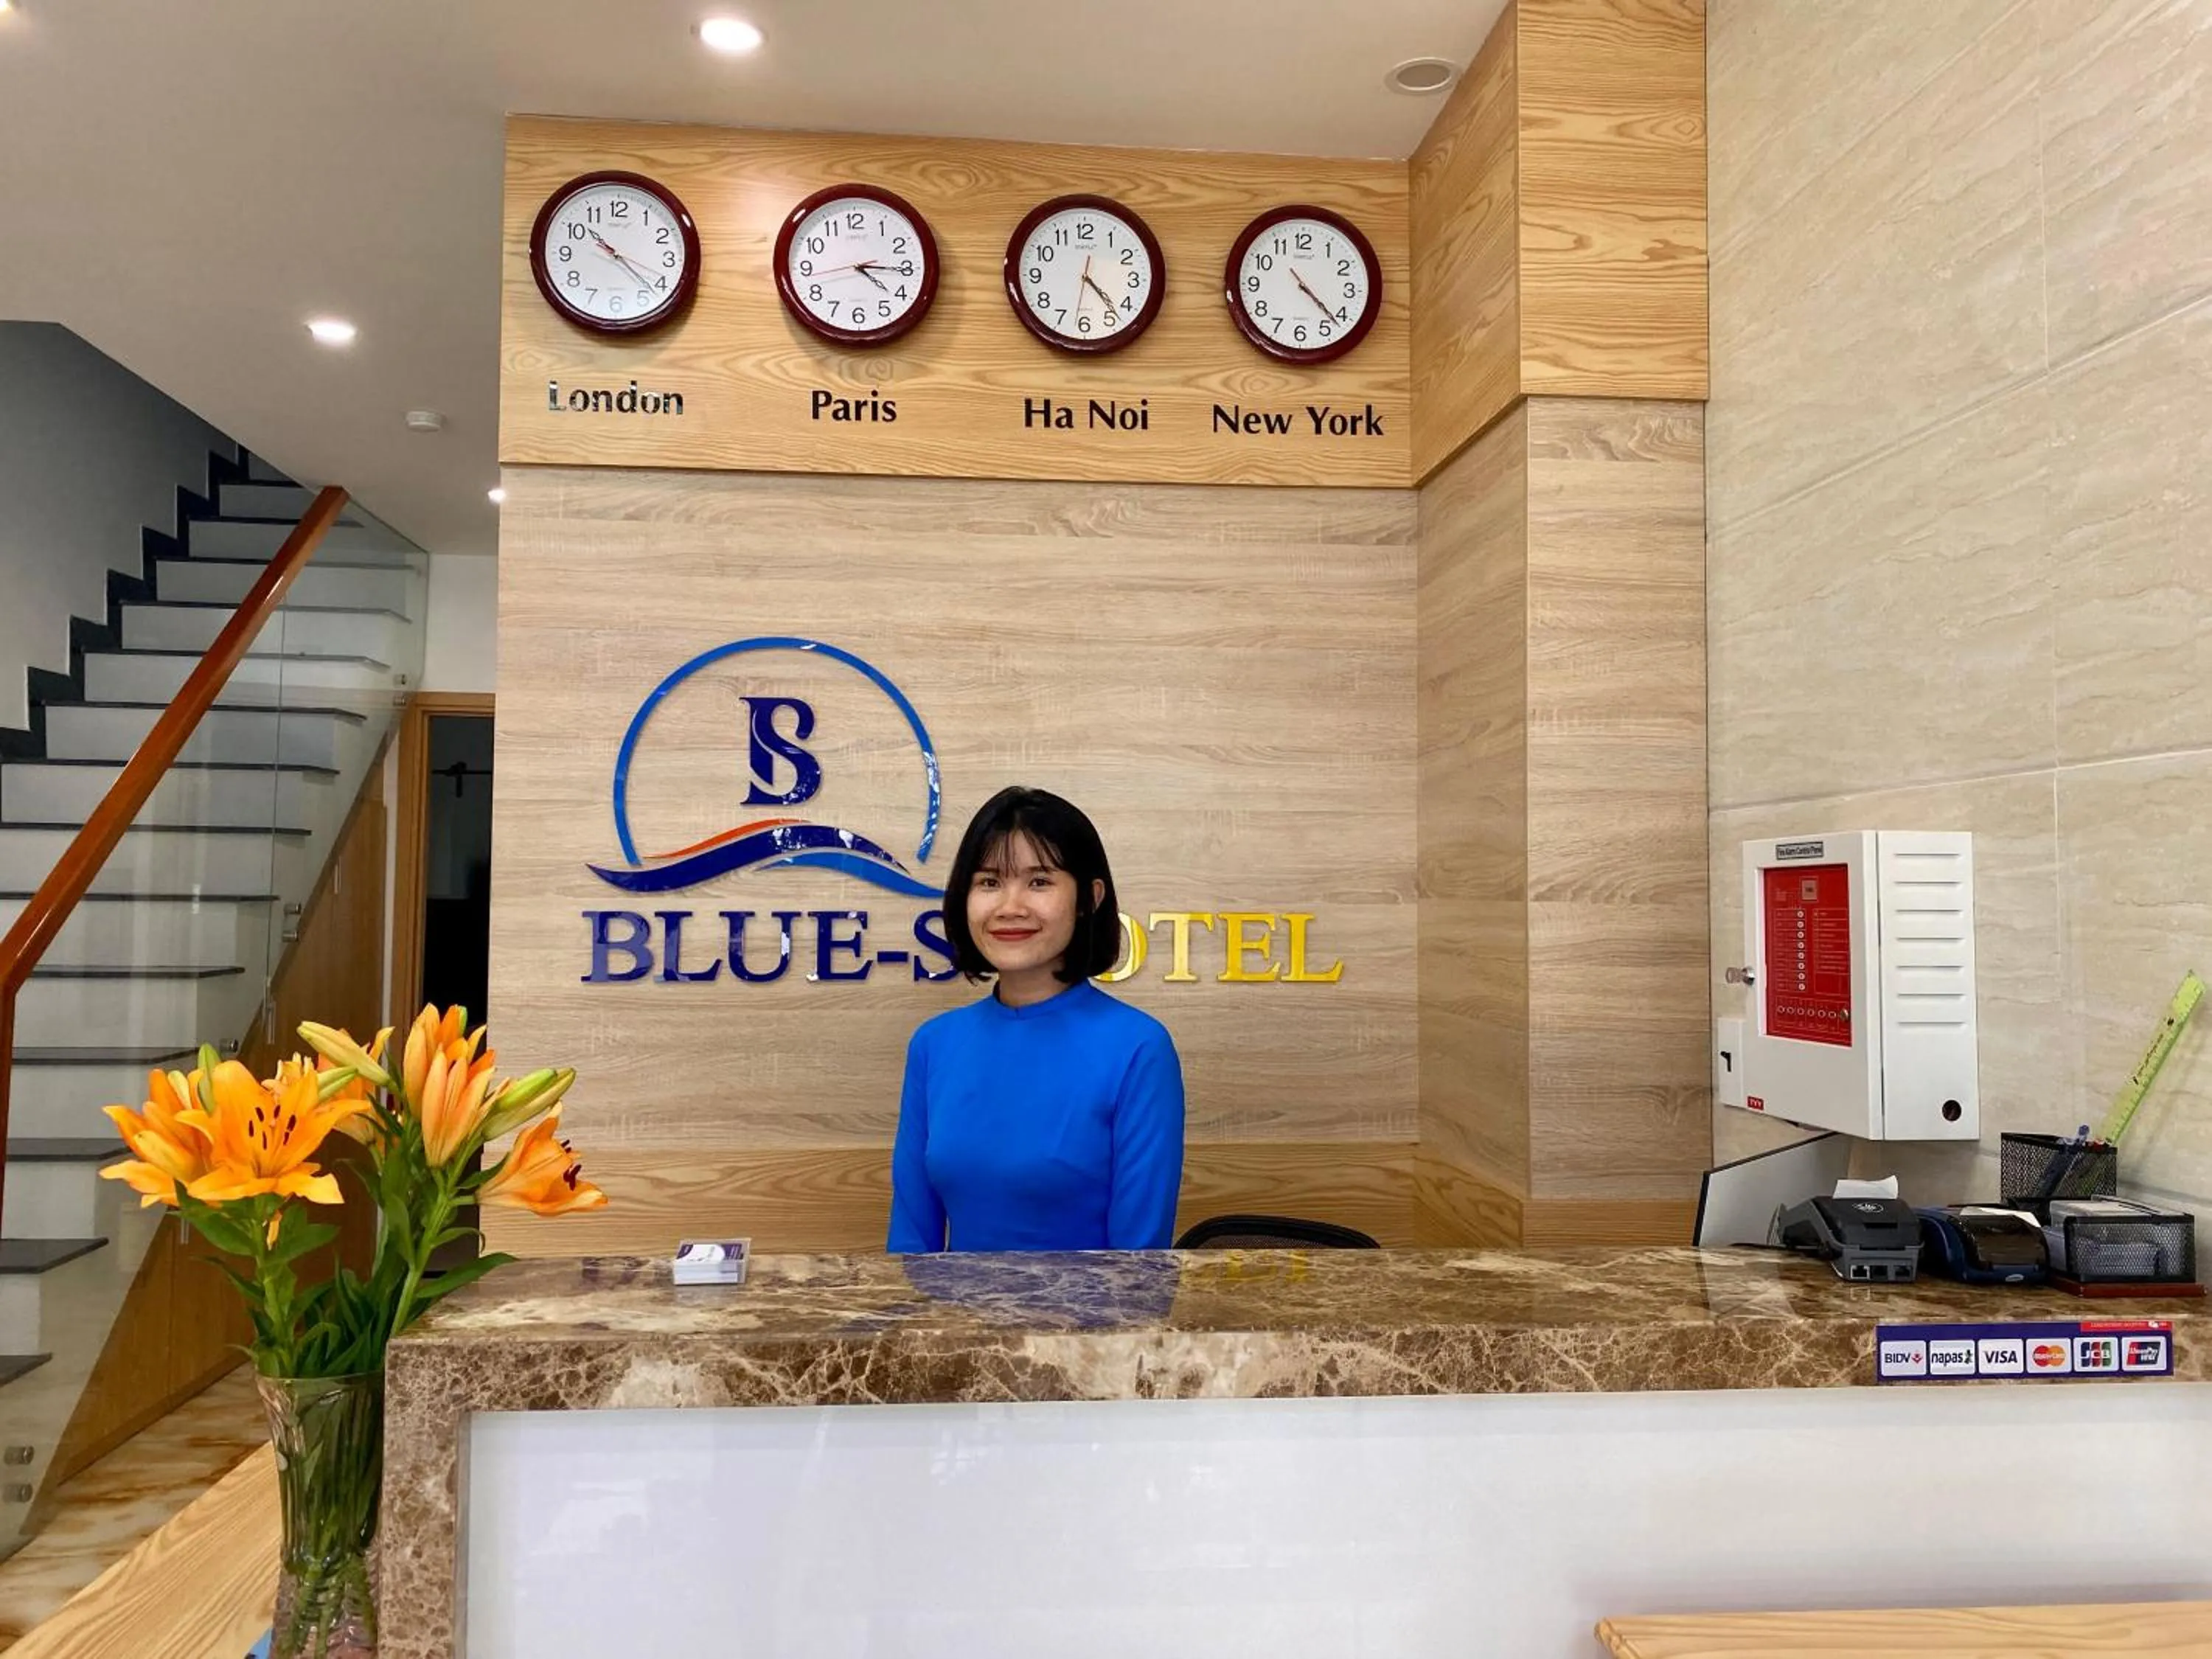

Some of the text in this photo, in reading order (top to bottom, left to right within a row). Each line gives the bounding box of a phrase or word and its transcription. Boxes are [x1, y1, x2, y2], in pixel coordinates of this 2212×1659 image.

[587, 207, 601, 223] 11
[611, 201, 628, 218] 12
[643, 209, 648, 226] 1
[825, 220, 838, 236] 11
[846, 214, 864, 229] 12
[879, 221, 884, 236] 1
[568, 223, 585, 240] 10
[655, 229, 669, 244] 2
[1055, 229, 1068, 246] 11
[1077, 223, 1093, 240] 12
[807, 237, 824, 254] 10
[893, 237, 905, 254] 2
[1108, 232, 1113, 248] 1
[1274, 238, 1287, 255] 11
[1295, 233, 1312, 250] 12
[559, 246, 571, 262] 9
[1037, 246, 1054, 262] 10
[1121, 249, 1133, 265] 2
[1326, 242, 1331, 258] 1
[663, 251, 675, 268] 3
[1256, 254, 1273, 271] 10
[800, 260, 813, 276] 9
[900, 260, 914, 276] 3
[1029, 268, 1042, 284] 9
[1338, 260, 1350, 276] 2
[567, 271, 580, 288] 8
[654, 276, 667, 292] 4
[1127, 271, 1139, 288] 3
[1248, 276, 1259, 292] 9
[585, 288, 598, 305] 7
[637, 290, 650, 307] 5
[810, 284, 822, 301] 8
[894, 285, 907, 301] 4
[1343, 283, 1355, 299] 3
[609, 296, 622, 312] 6
[1037, 292, 1050, 308] 8
[1121, 296, 1133, 311] 4
[828, 301, 840, 317] 7
[852, 307, 865, 324] 6
[878, 301, 891, 316] 5
[1255, 301, 1267, 316] 8
[1336, 307, 1347, 321] 4
[1054, 310, 1066, 324] 7
[1078, 317, 1091, 333] 6
[1104, 310, 1116, 327] 5
[1272, 318, 1284, 333] 7
[1294, 325, 1306, 341] 6
[1319, 321, 1331, 336] 5
[548, 381, 684, 414] London
[812, 390, 897, 422] Paris
[1024, 398, 1149, 430] Ha Noi
[1213, 404, 1384, 436] New York
[1885, 1353, 1910, 1363] BIDV
[1931, 1352, 1963, 1366] napas
[1983, 1351, 2017, 1363] VISA
